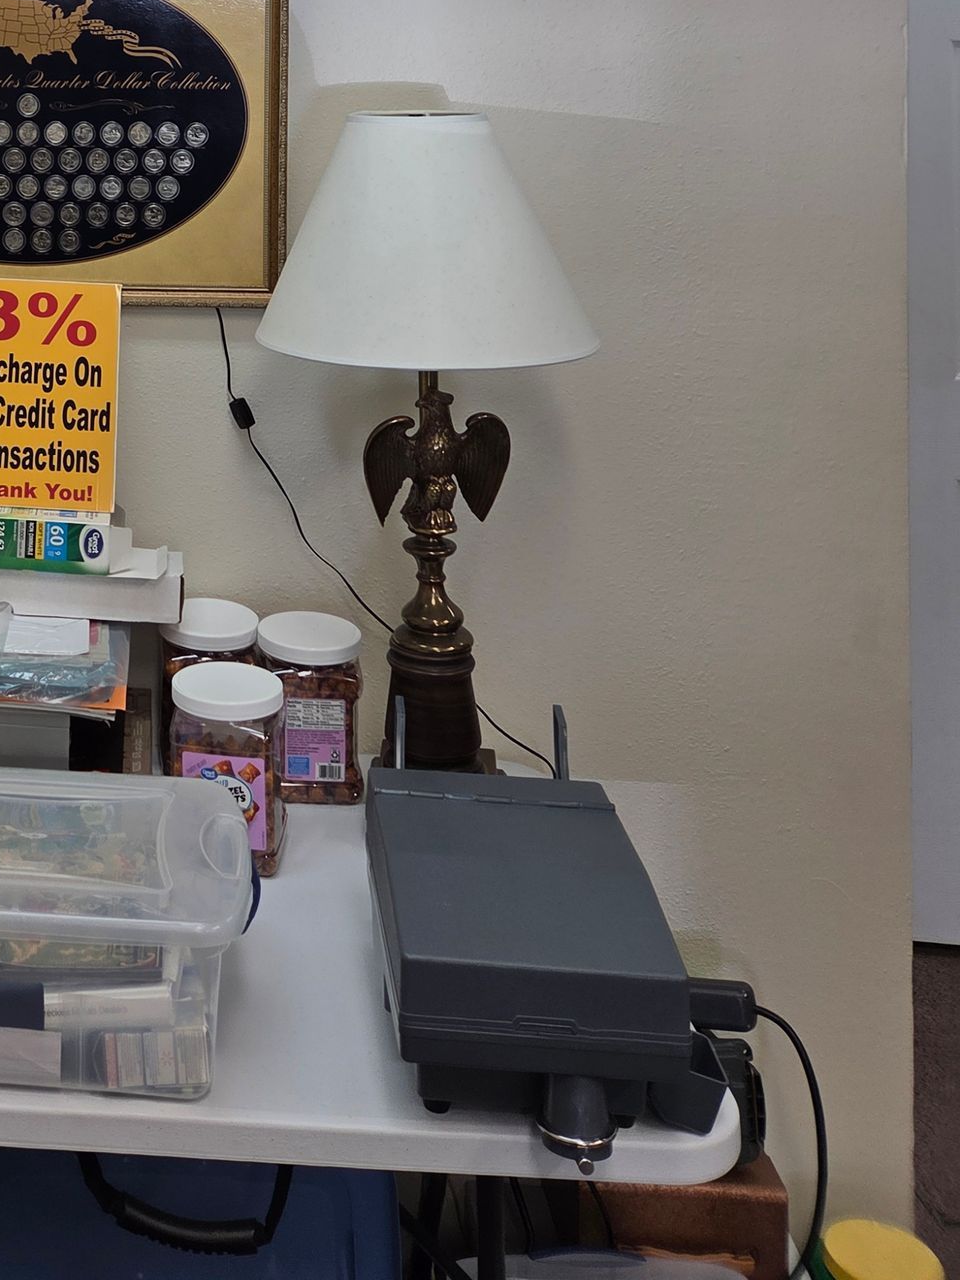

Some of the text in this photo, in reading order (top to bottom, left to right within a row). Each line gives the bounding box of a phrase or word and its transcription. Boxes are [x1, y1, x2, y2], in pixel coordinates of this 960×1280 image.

[23, 70, 90, 90] Quarter
[94, 70, 151, 90] Dollar
[151, 68, 231, 91] Collection
[74, 356, 102, 388] On
[62, 400, 111, 433] Card
[44, 483, 93, 502] You!
[50, 525, 64, 546] 60
[92, 532, 100, 554] Great
